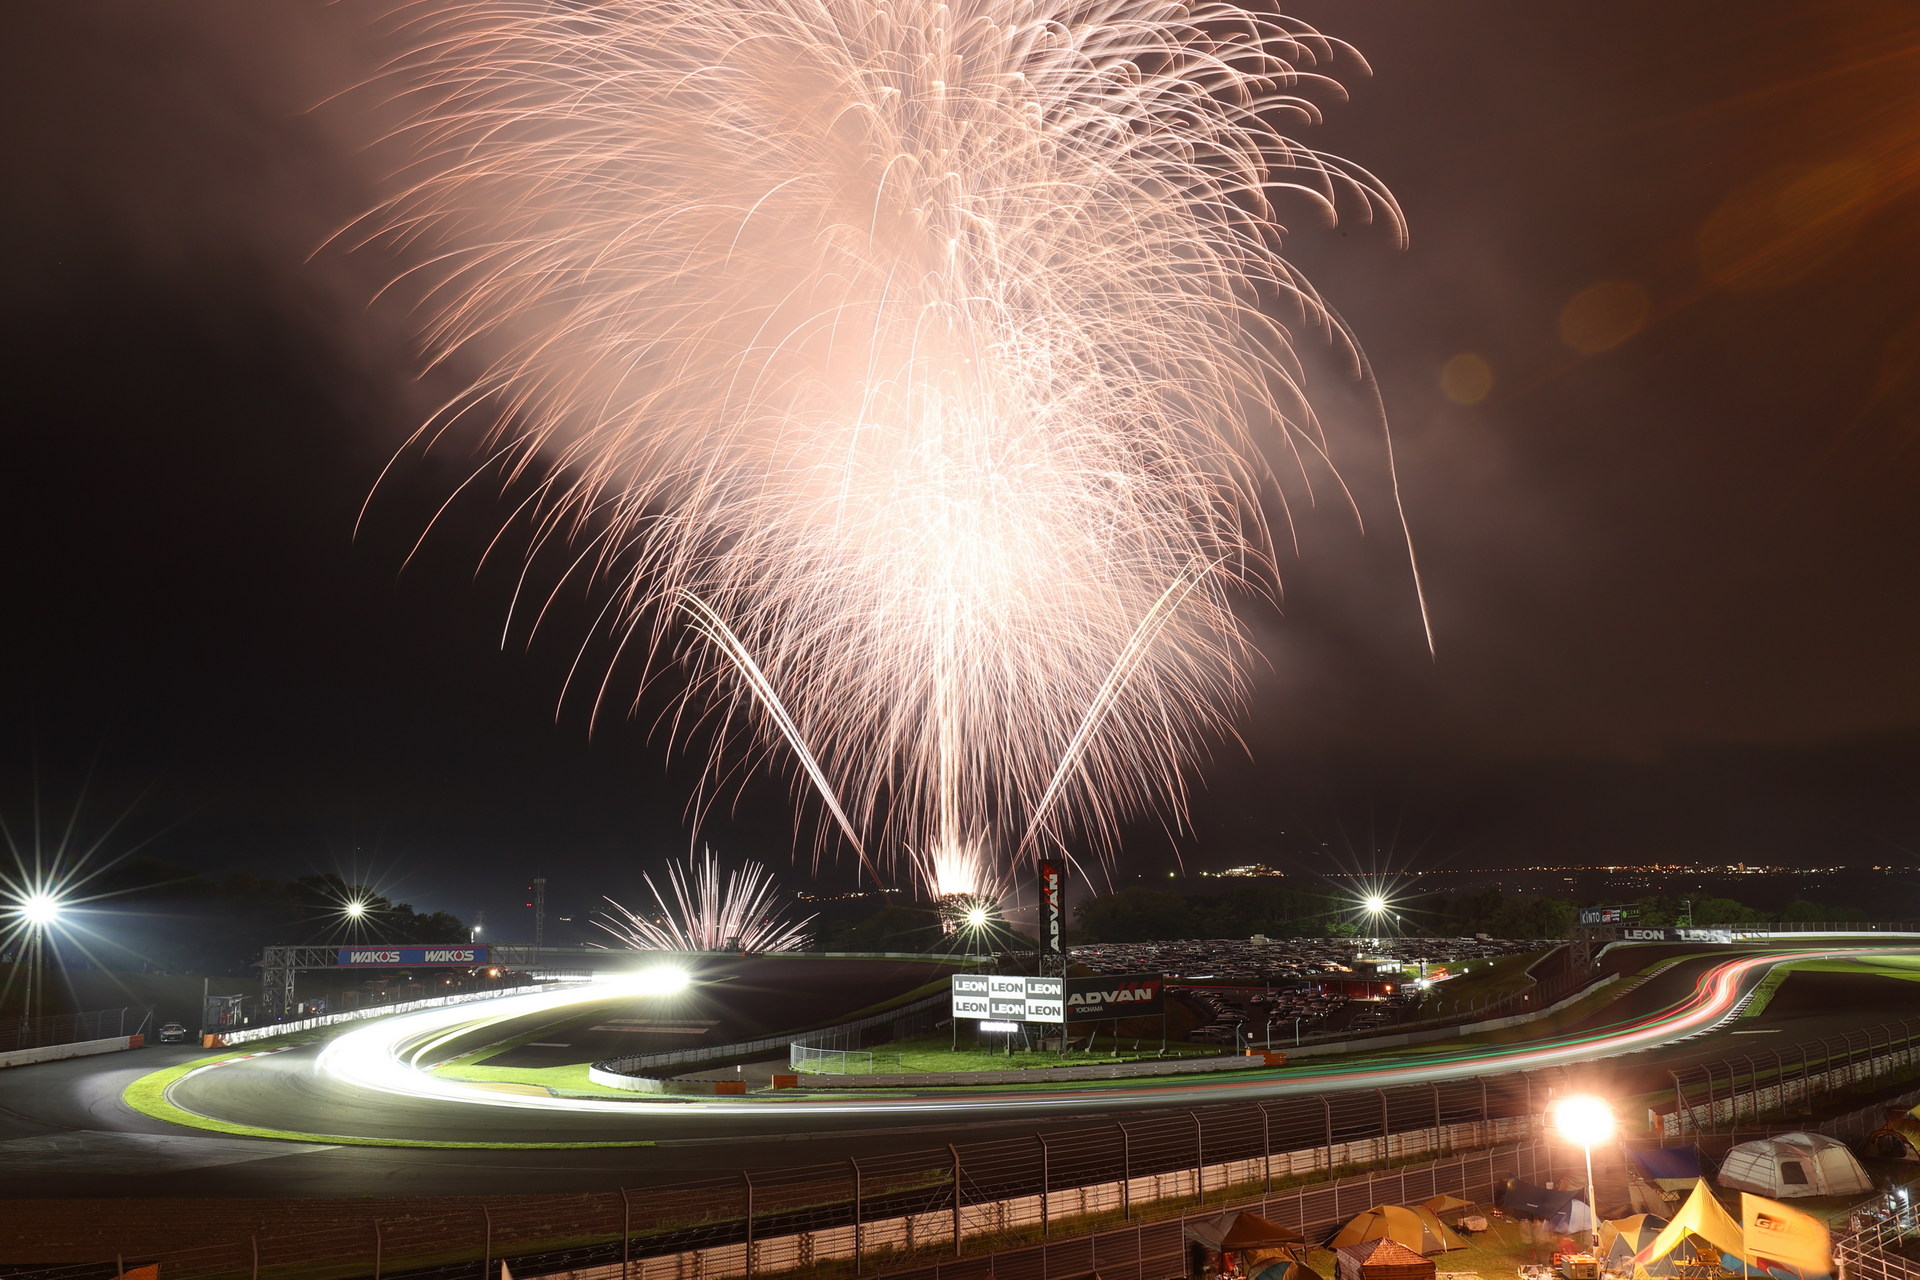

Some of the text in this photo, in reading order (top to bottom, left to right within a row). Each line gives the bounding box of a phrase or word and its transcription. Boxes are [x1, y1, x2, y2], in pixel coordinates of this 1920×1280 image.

[1049, 873, 1061, 952] ADVAN
[1624, 929, 1665, 940] LEON
[955, 981, 1061, 995] LEON LEON LEON
[1067, 988, 1152, 1006] ADVAN
[955, 1002, 1061, 1016] LEON LEON LEON
